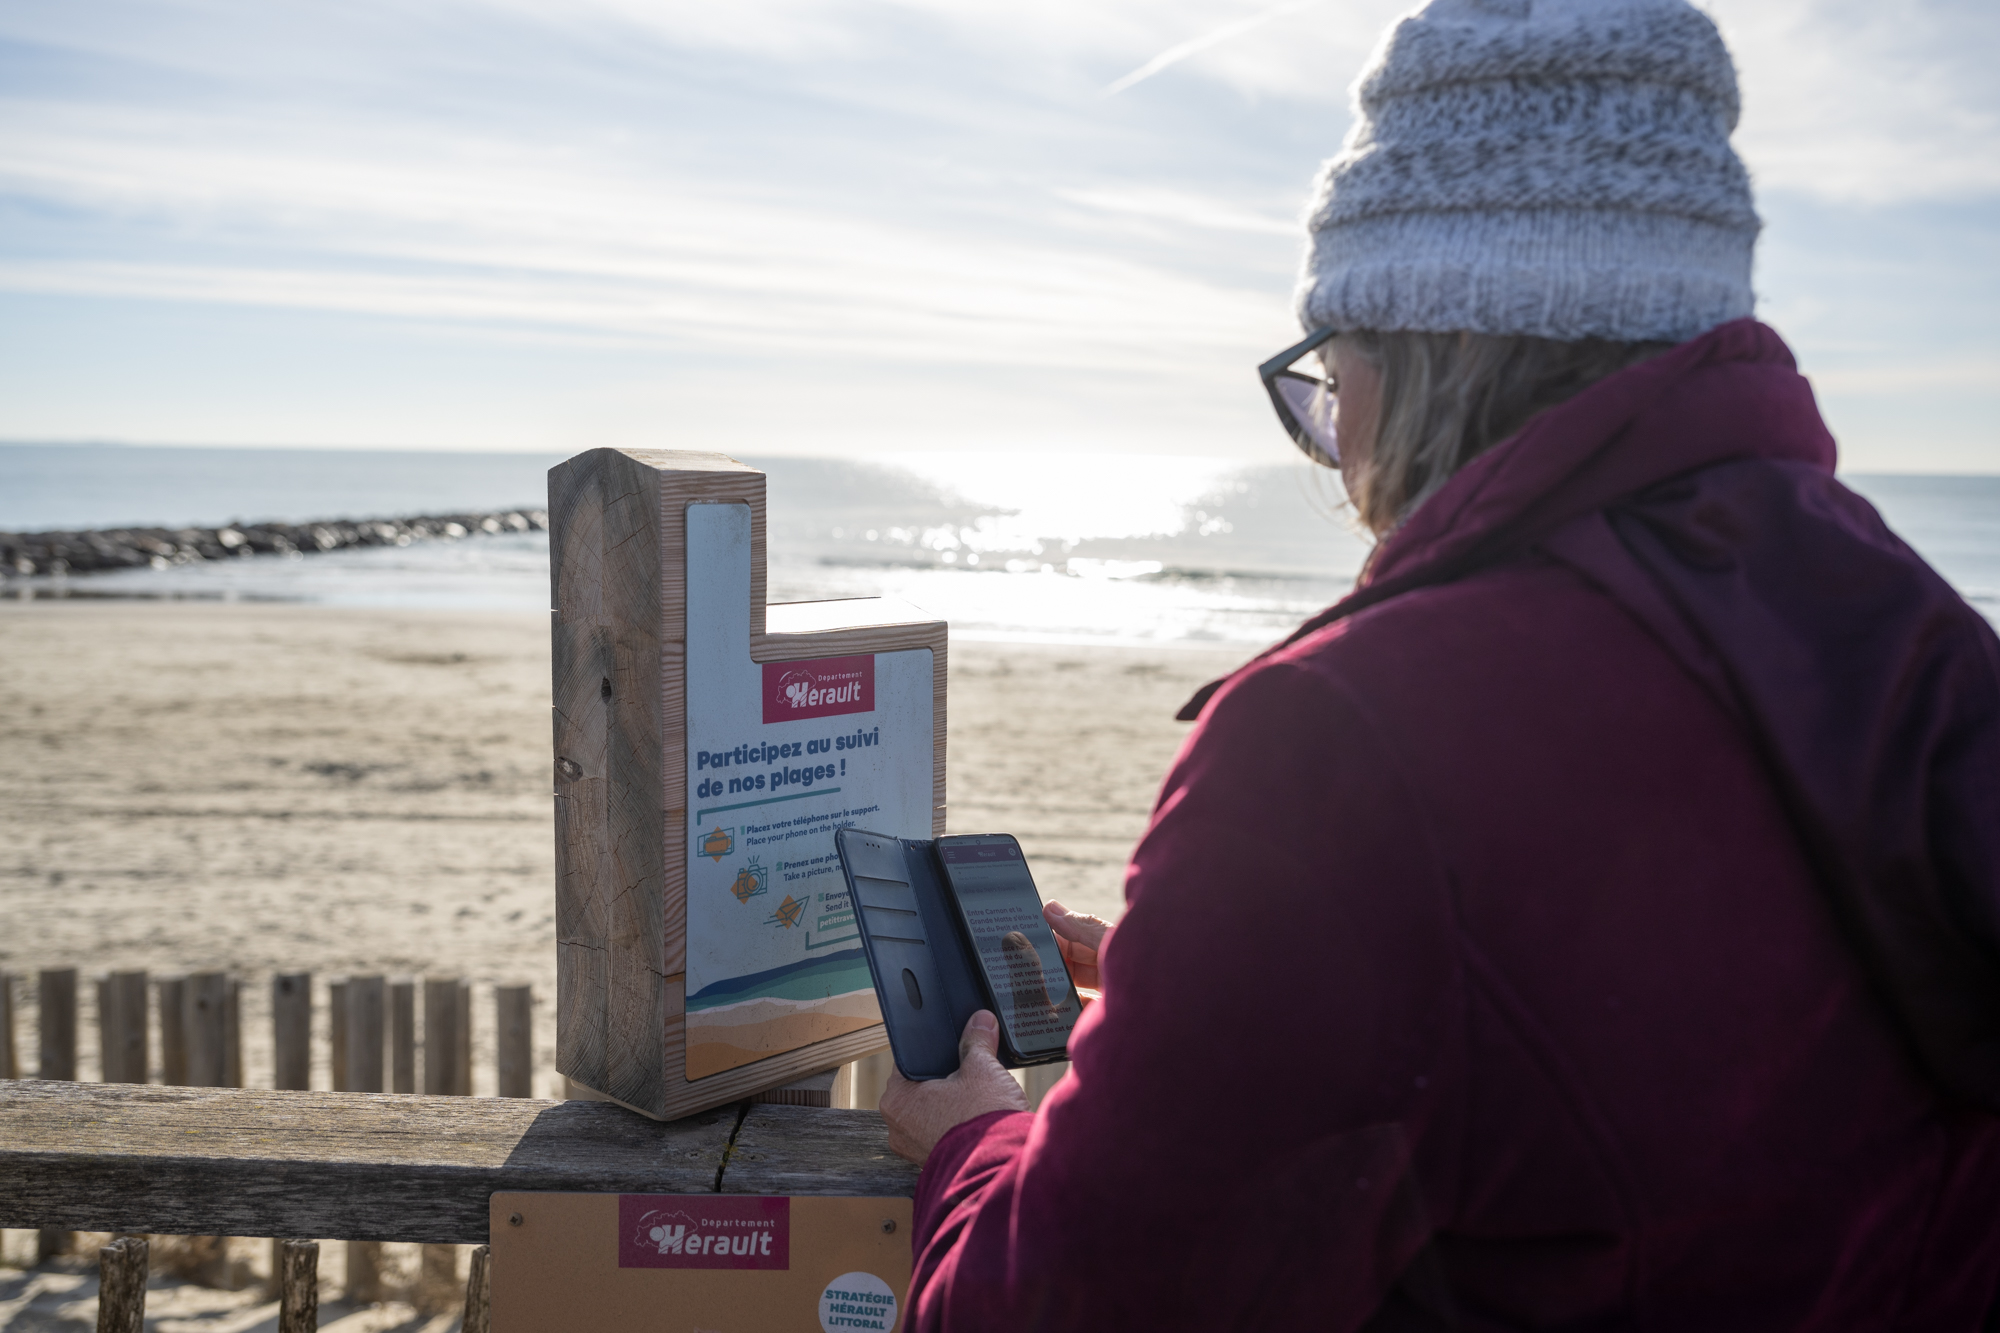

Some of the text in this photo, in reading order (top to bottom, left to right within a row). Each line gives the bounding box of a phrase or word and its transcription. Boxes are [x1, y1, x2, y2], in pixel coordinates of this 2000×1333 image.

[697, 726, 879, 770] Participez au suivi
[697, 758, 846, 798] de nos plages !
[740, 804, 880, 836] 1 Placez votre téléphone sur le support.
[746, 836, 766, 846] Place
[767, 833, 784, 844] your
[785, 828, 808, 841] phone
[819, 823, 831, 833] the
[832, 819, 856, 830] holder.
[776, 853, 839, 872] 2 Prenez une pho
[784, 872, 800, 881] Take
[807, 866, 834, 878] picture,
[825, 890, 849, 901] Envoye
[825, 902, 843, 912] Send
[820, 913, 855, 929] petittrave
[825, 1289, 894, 1305] STRATÉGIE
[830, 1302, 887, 1317] HÉRAULT
[828, 1316, 885, 1330] LITTORAL
